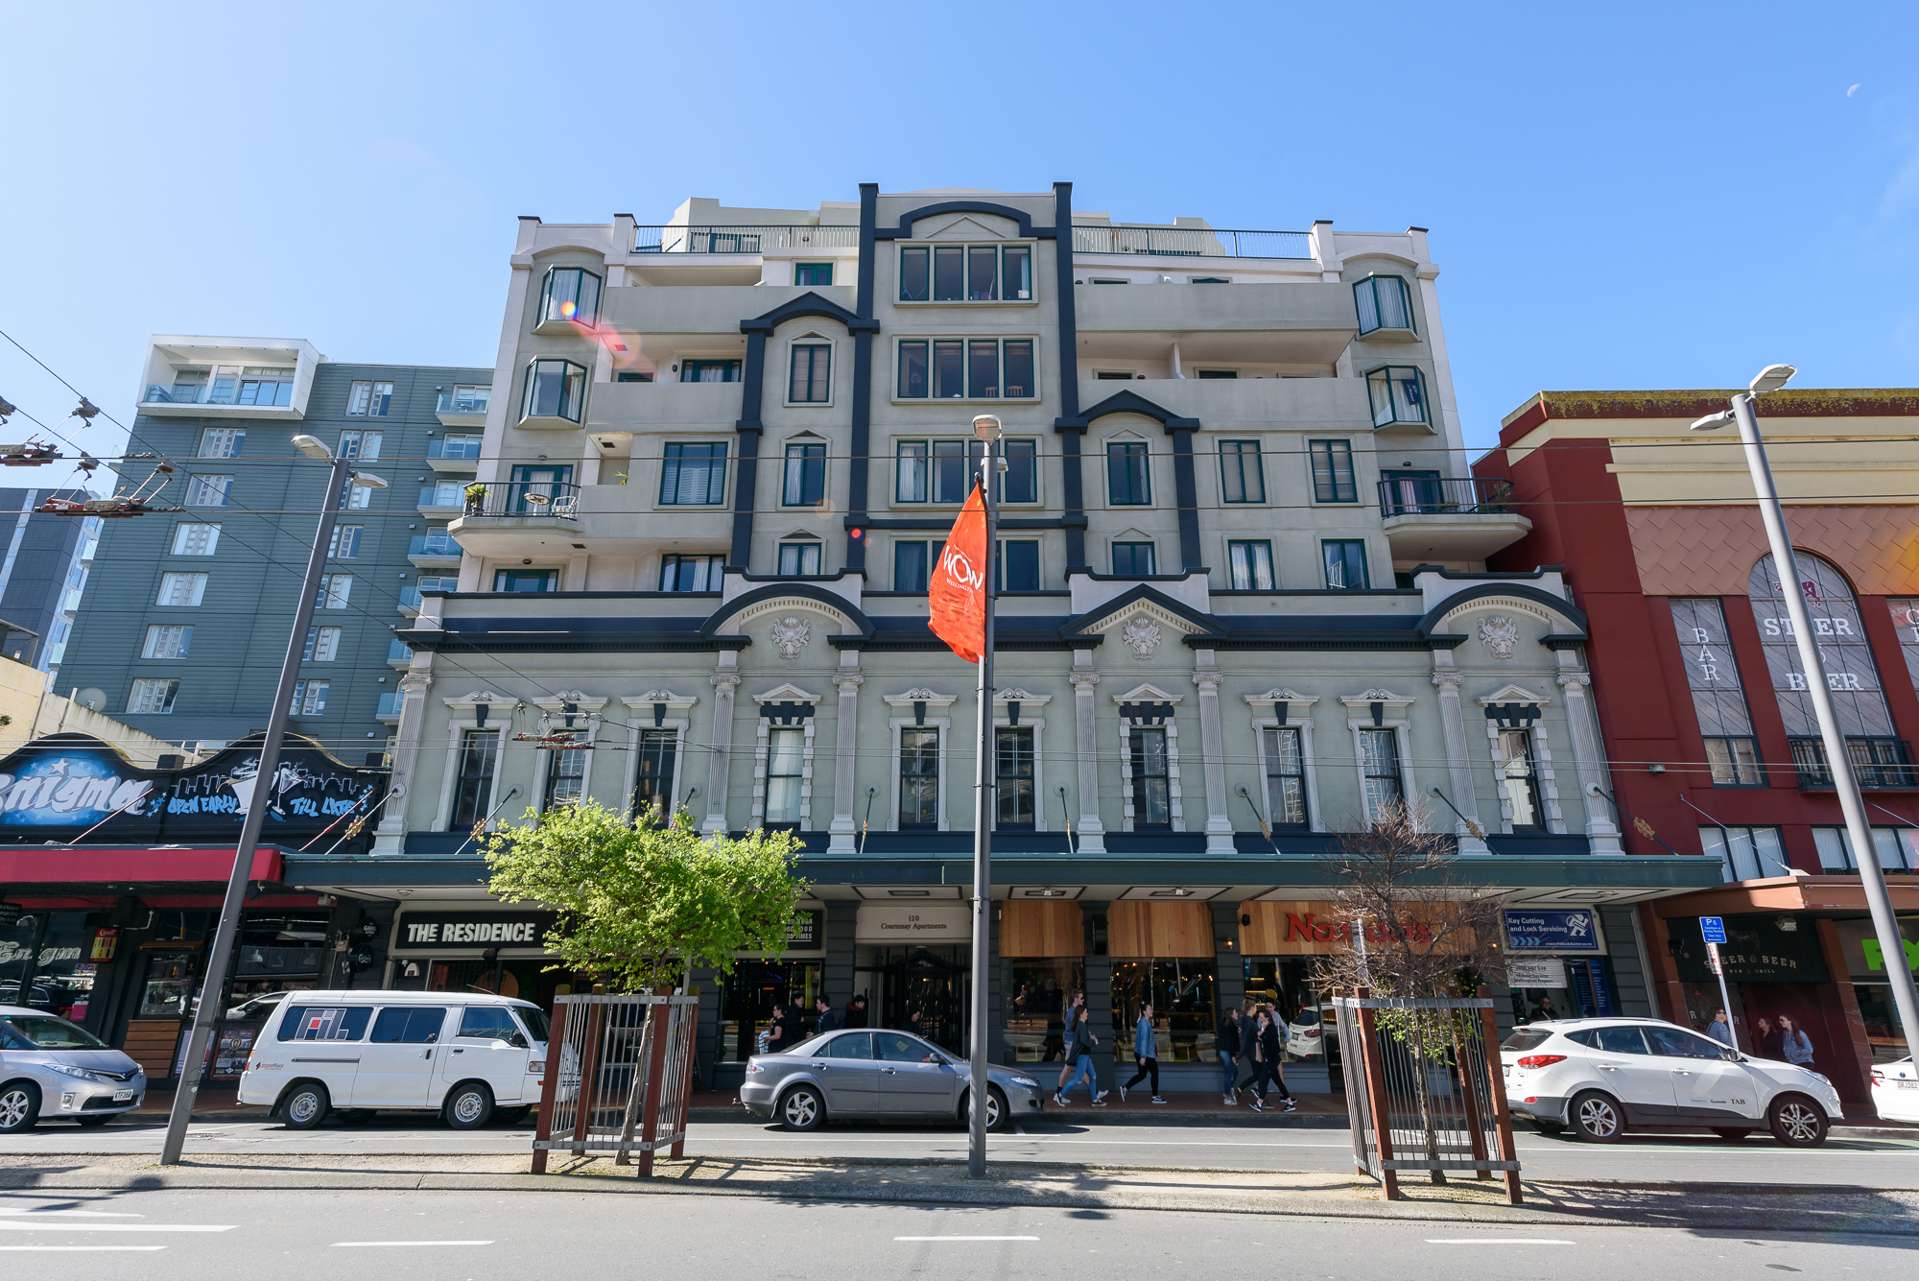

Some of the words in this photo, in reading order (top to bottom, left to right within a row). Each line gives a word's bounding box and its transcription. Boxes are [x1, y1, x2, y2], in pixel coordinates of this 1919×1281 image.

[943, 545, 983, 590] WOW
[1764, 617, 1854, 636] STER
[1692, 628, 1720, 681] BAR
[1786, 673, 1864, 691] BER
[167, 794, 199, 815] OPEN
[290, 796, 319, 817] TILL
[1286, 911, 1431, 944] Nados
[1521, 917, 1545, 925] Cutting
[408, 923, 439, 942] THE
[441, 923, 536, 942] RESIDENCE
[1703, 954, 1746, 969] SEER
[1761, 954, 1798, 969] BEER
